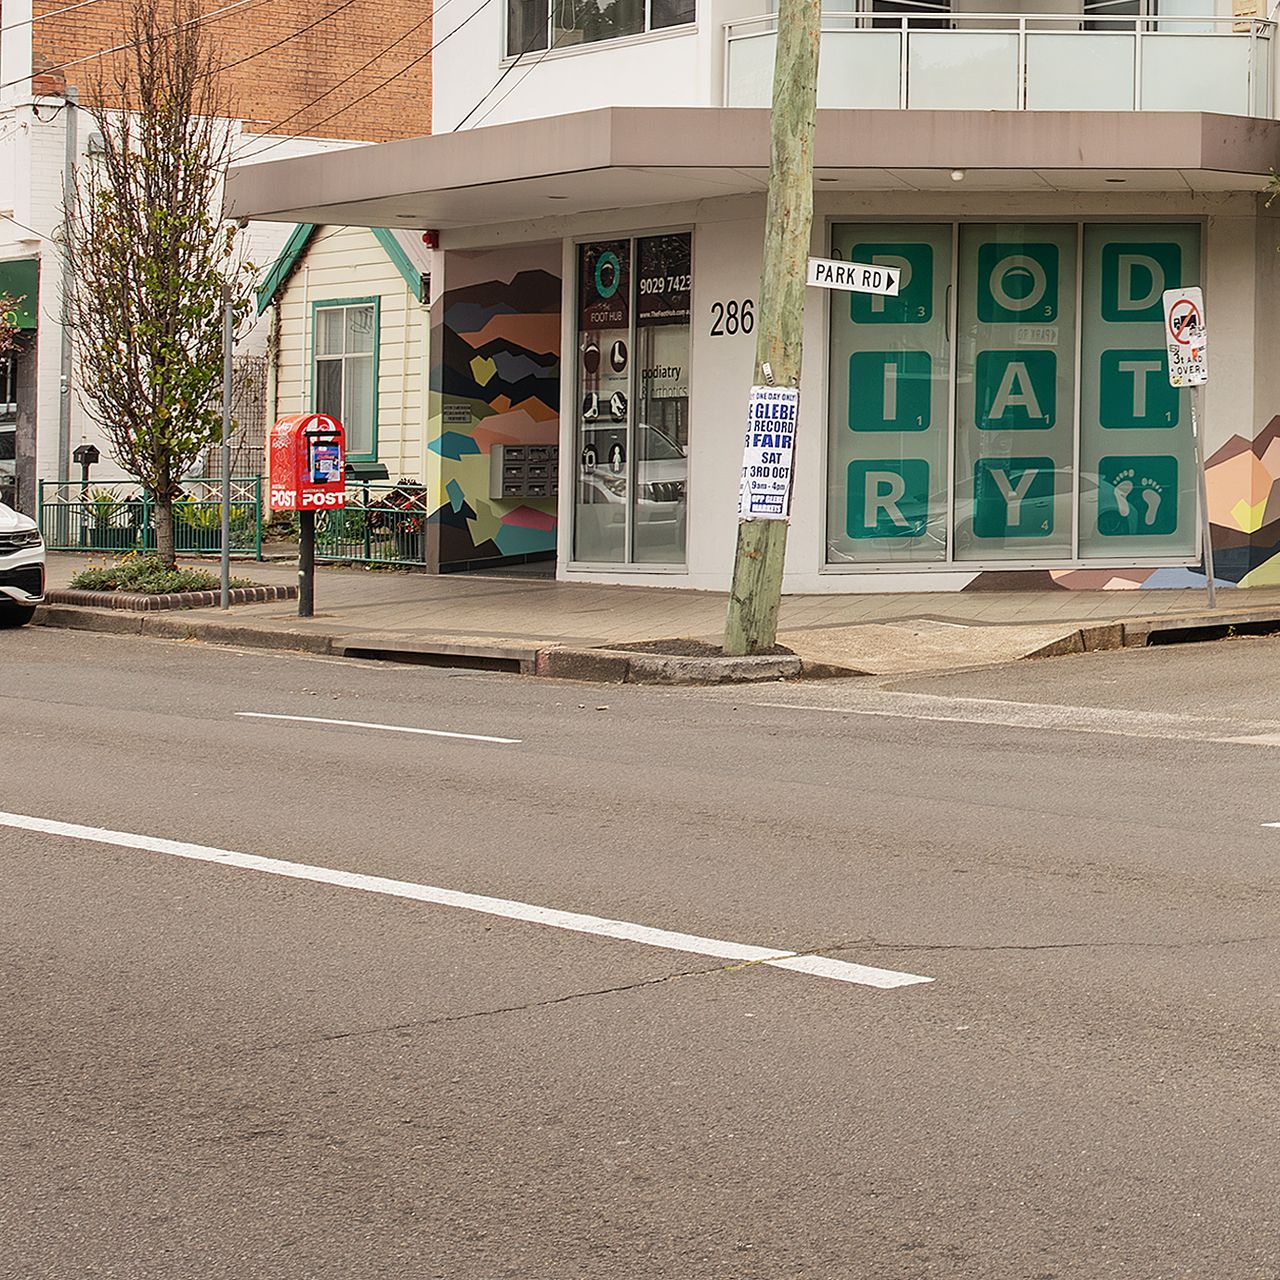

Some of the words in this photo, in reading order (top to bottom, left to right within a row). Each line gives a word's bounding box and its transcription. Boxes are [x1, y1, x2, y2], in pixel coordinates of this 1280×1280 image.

[815, 264, 856, 286] PARK
[862, 270, 882, 289] RD
[1117, 254, 1165, 312] D
[640, 277, 665, 295] 9029
[591, 312, 608, 322] FOOT
[609, 311, 623, 321] HUB
[710, 299, 755, 337] 286
[641, 365, 681, 381] podiatry
[1177, 365, 1200, 375] OVER
[756, 392, 767, 400] ONE
[1118, 360, 1162, 417] T
[755, 403, 795, 420] GLEBE
[754, 420, 794, 433] RECORD
[753, 433, 792, 449] FAIR
[761, 452, 782, 464] SAT
[750, 466, 770, 478] 3RD
[772, 467, 789, 479] OCT
[751, 481, 767, 490] 9am
[271, 489, 297, 507] POST
[302, 492, 345, 506] POST
